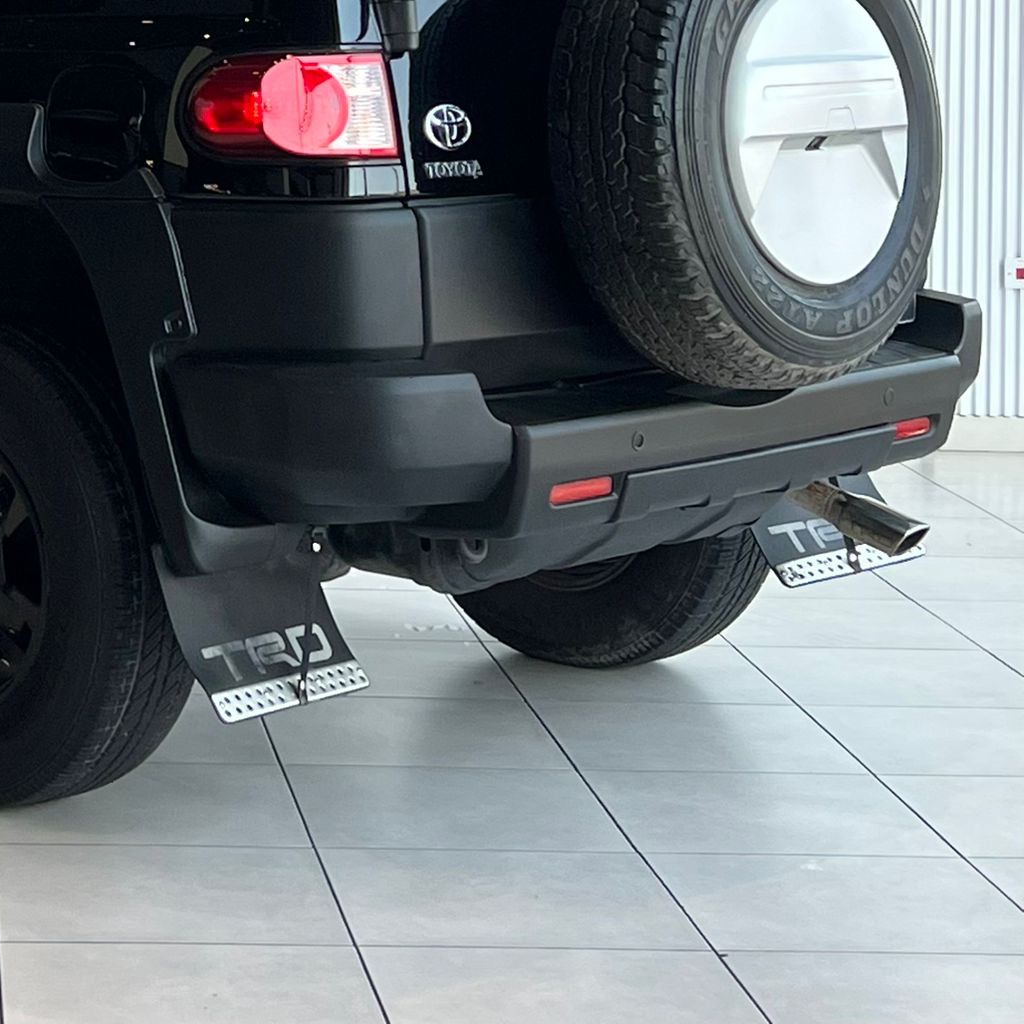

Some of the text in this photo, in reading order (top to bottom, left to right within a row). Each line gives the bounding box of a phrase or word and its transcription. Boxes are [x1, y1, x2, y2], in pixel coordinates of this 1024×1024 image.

[424, 160, 483, 179] TOYOTA
[836, 216, 925, 334] DUNLOP
[768, 518, 844, 553] TR
[200, 623, 333, 682] TRD
